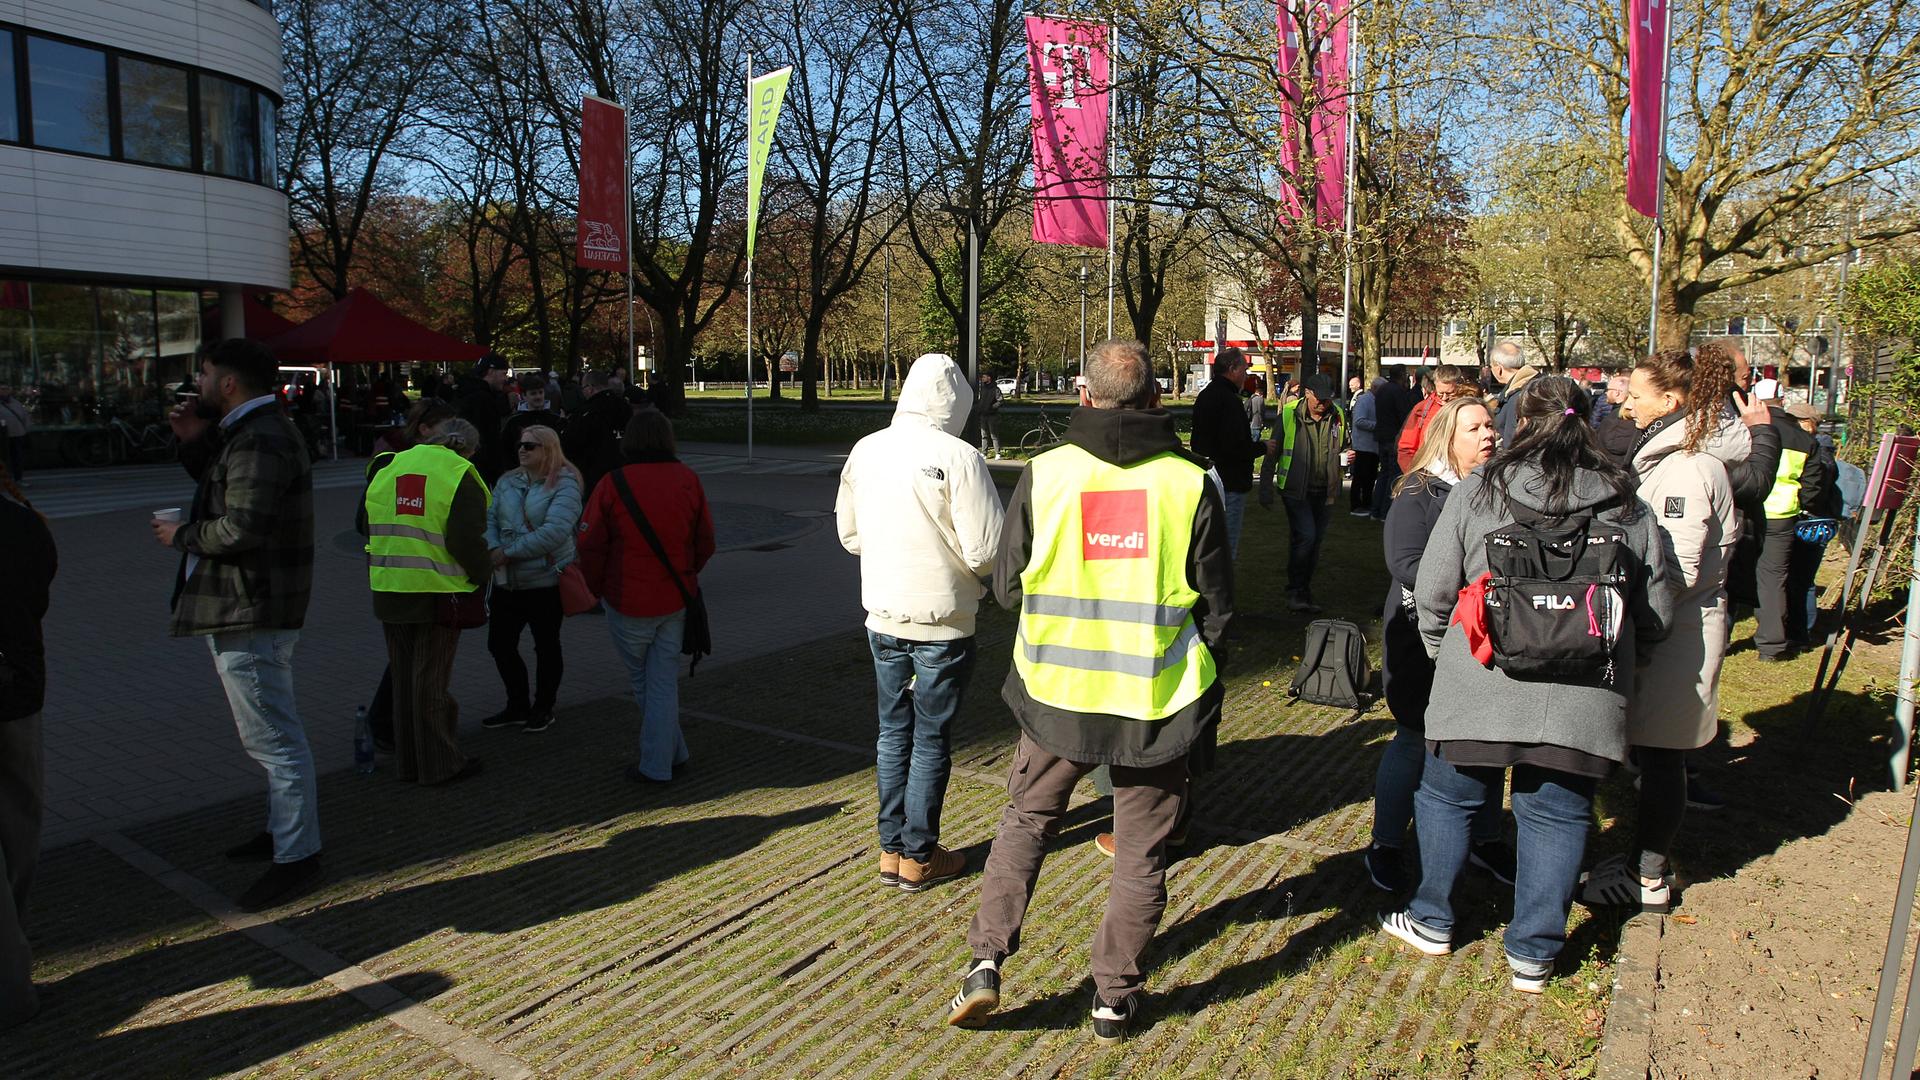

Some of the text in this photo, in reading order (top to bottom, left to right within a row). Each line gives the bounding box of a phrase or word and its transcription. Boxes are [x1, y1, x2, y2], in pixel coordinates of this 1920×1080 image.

[1043, 42, 1091, 109] T
[396, 496, 423, 508] er.di
[1086, 531, 1145, 549] ver.di
[1494, 538, 1512, 547] FILA
[1587, 536, 1606, 545] FILA
[1486, 599, 1501, 607] FILA
[1532, 594, 1576, 610] FILA
